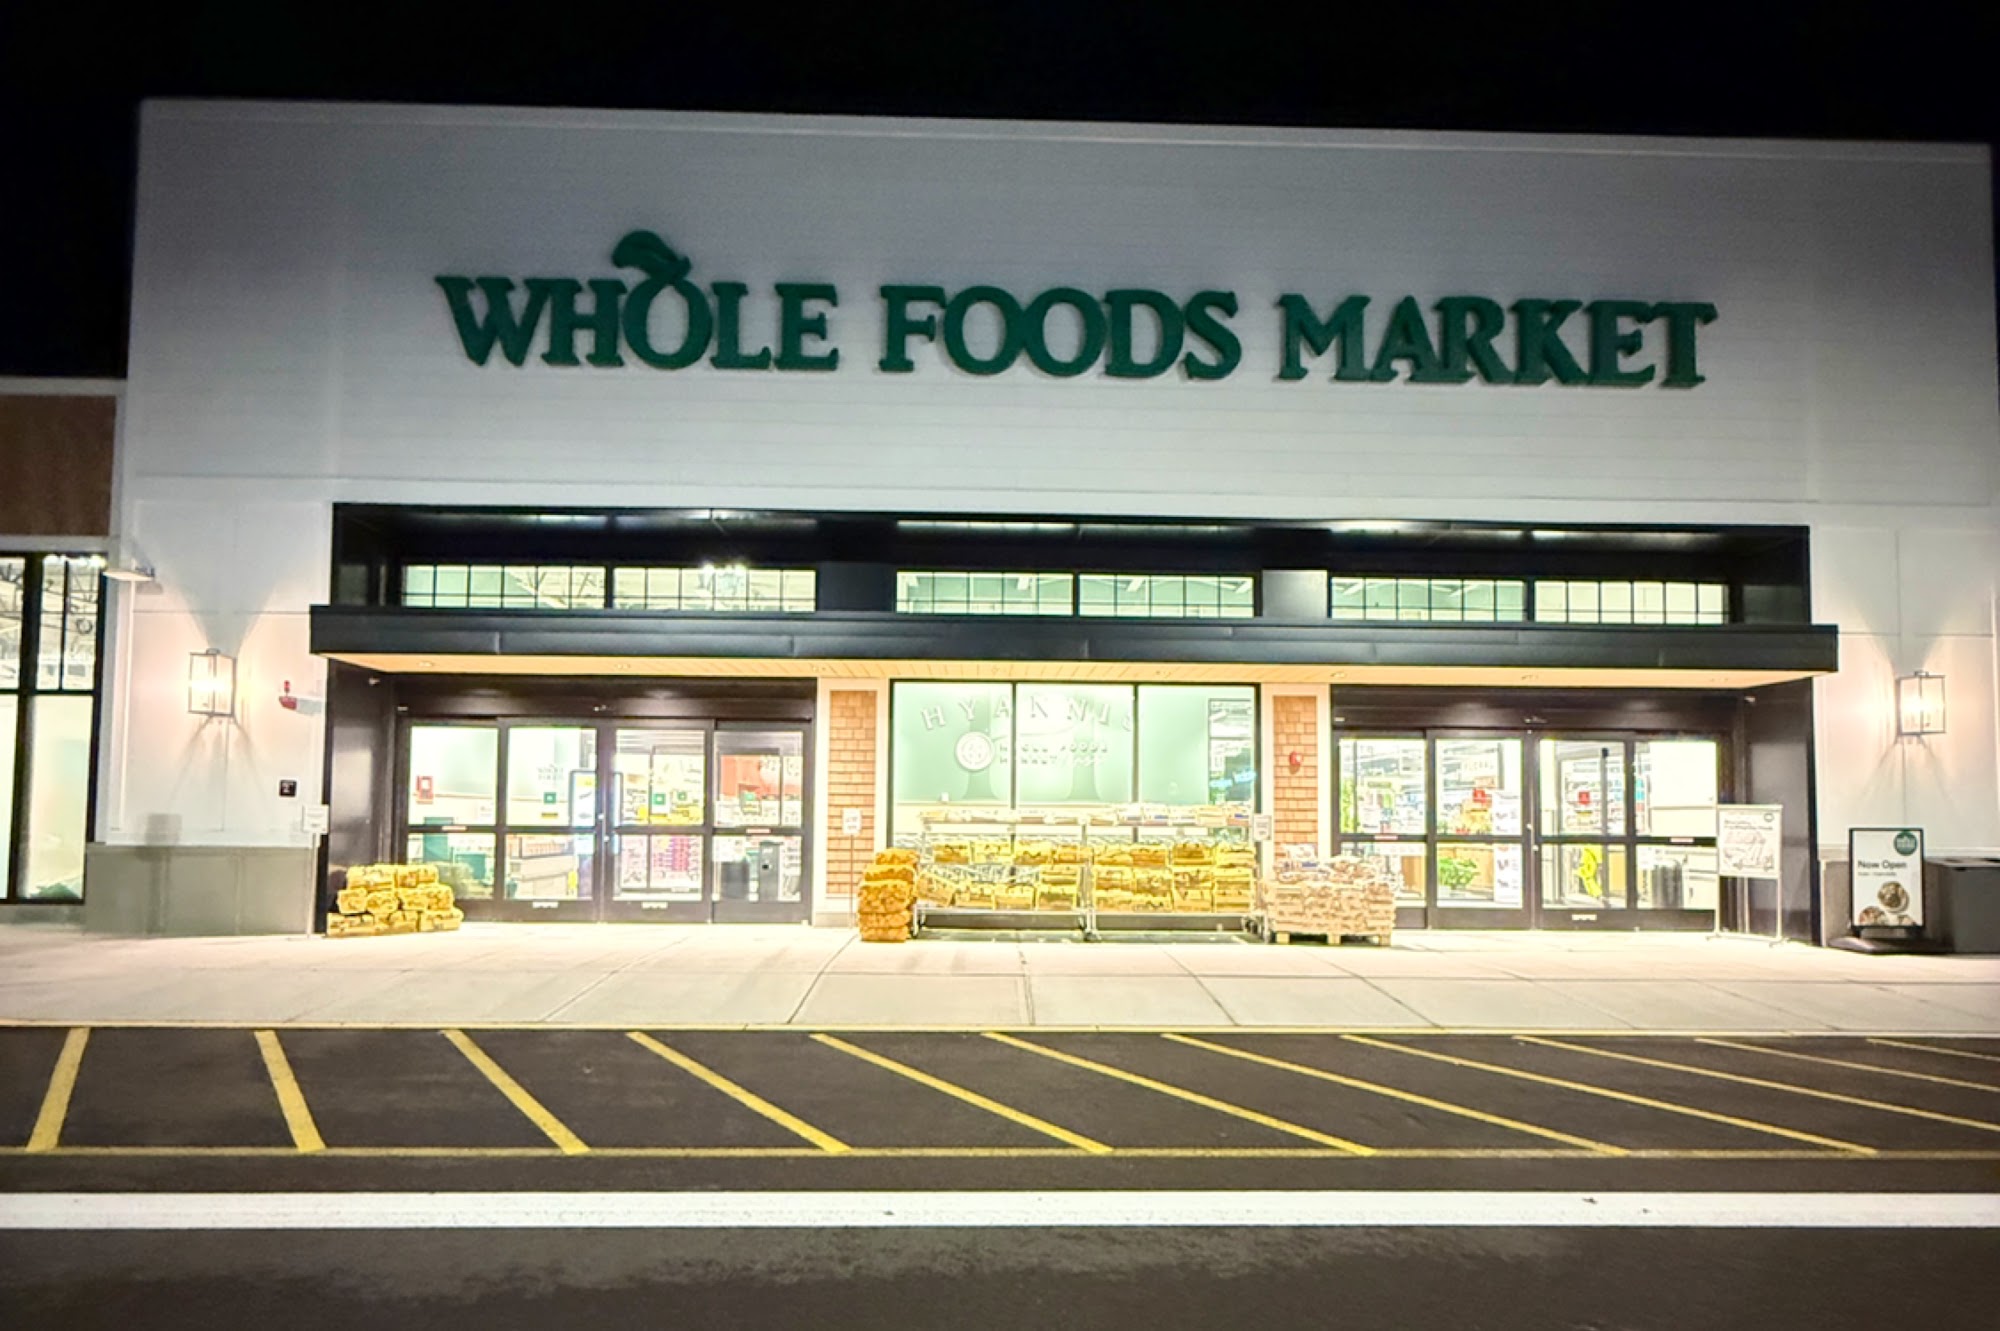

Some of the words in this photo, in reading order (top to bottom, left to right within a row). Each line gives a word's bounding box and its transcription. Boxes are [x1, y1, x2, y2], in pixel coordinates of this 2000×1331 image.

[435, 273, 840, 371] WHOLE
[880, 284, 1242, 379] FOODS
[1273, 293, 1719, 389] MARKET
[1857, 860, 1880, 869] Now
[1881, 860, 1907, 871] Open
